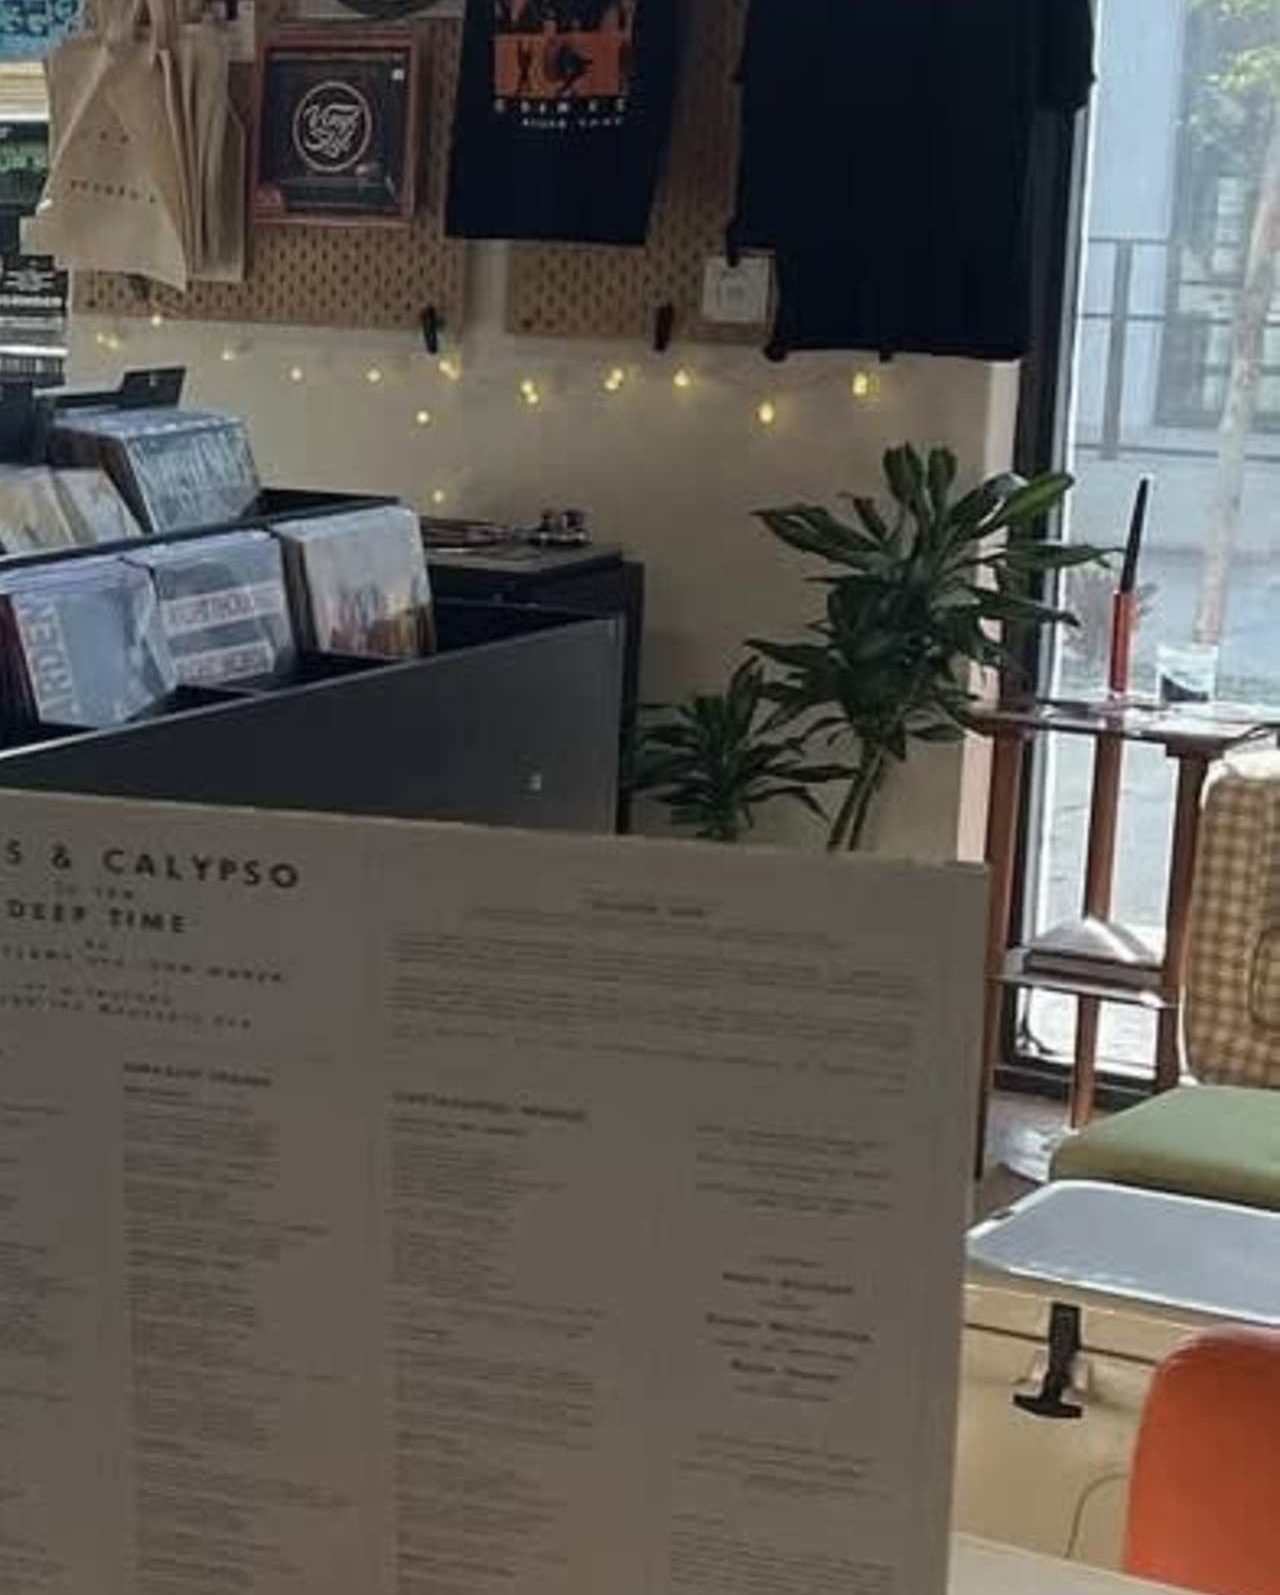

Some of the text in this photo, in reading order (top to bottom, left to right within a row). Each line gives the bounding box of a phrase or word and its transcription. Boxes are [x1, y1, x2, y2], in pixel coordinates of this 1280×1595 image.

[51, 844, 73, 870] &
[103, 850, 302, 891] CALYPSO
[6, 899, 187, 935] DEEP TIME
